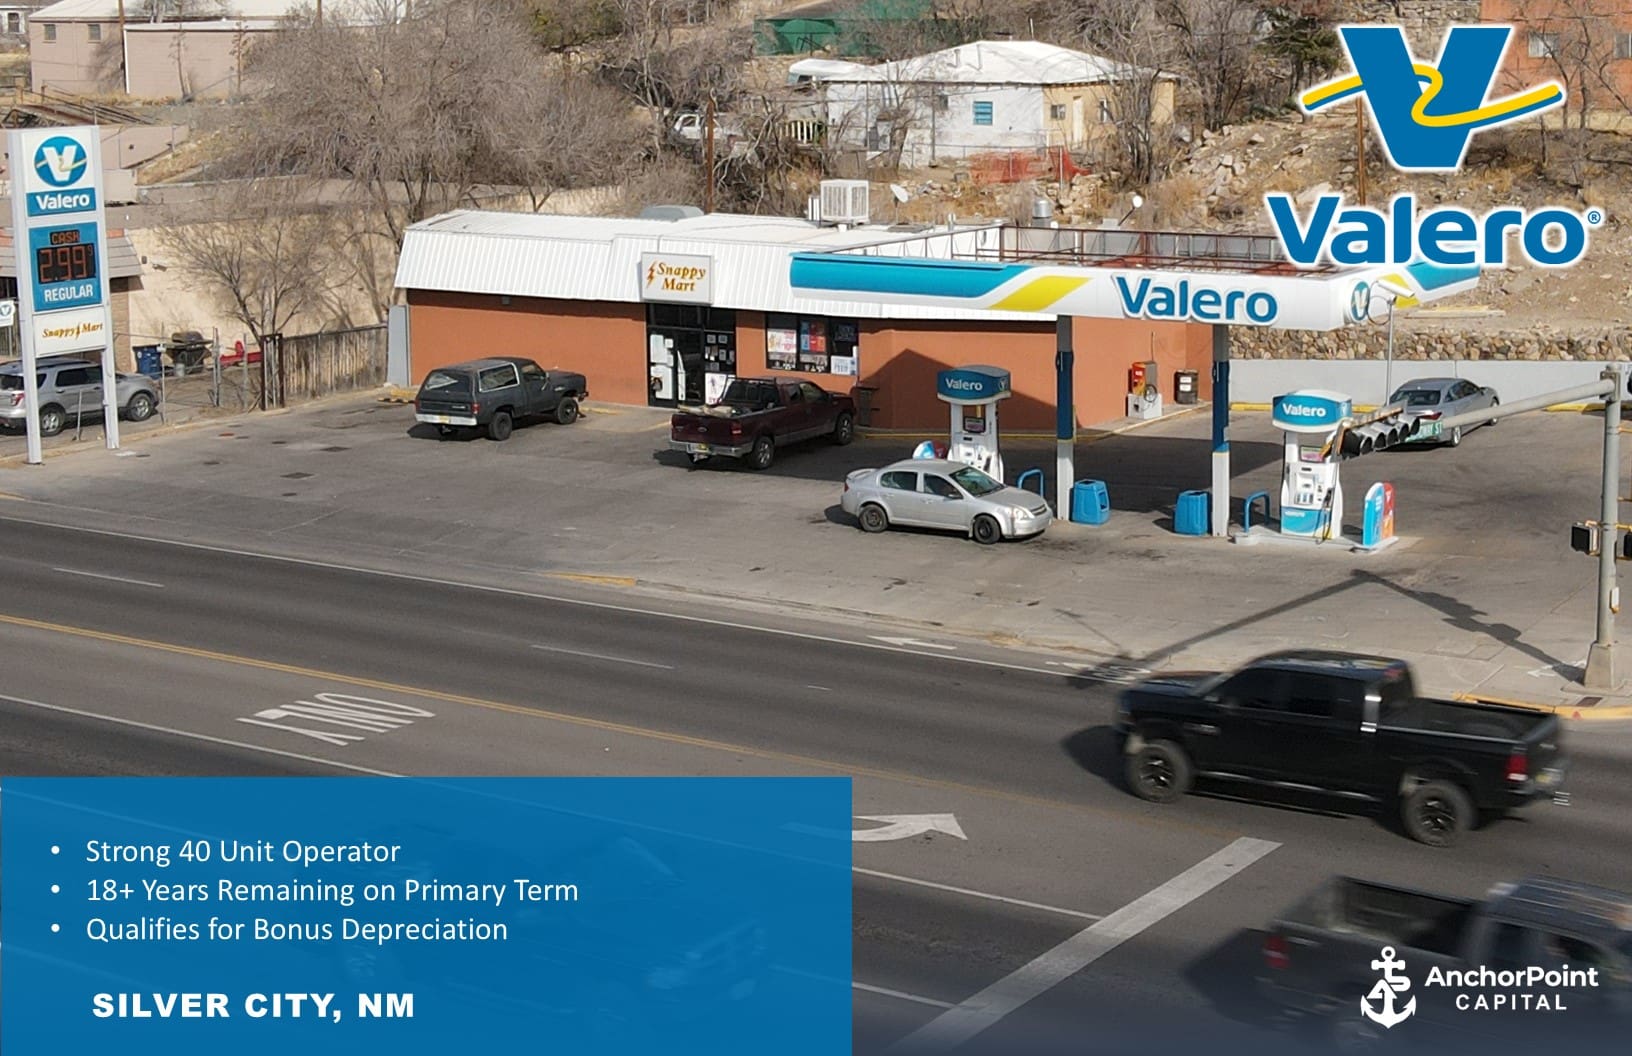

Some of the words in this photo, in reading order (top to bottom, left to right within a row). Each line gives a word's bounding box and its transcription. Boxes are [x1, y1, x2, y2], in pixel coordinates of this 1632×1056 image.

[36, 193, 91, 211] Valero
[51, 231, 80, 244] CASH
[657, 262, 706, 280] Snappy
[661, 277, 695, 292] Mart
[44, 284, 94, 302] REGULAR
[1117, 276, 1277, 322] Valero
[42, 326, 77, 338] Snappy
[82, 322, 103, 333] Mart
[944, 378, 983, 391] Valero
[1282, 402, 1327, 417] Valero
